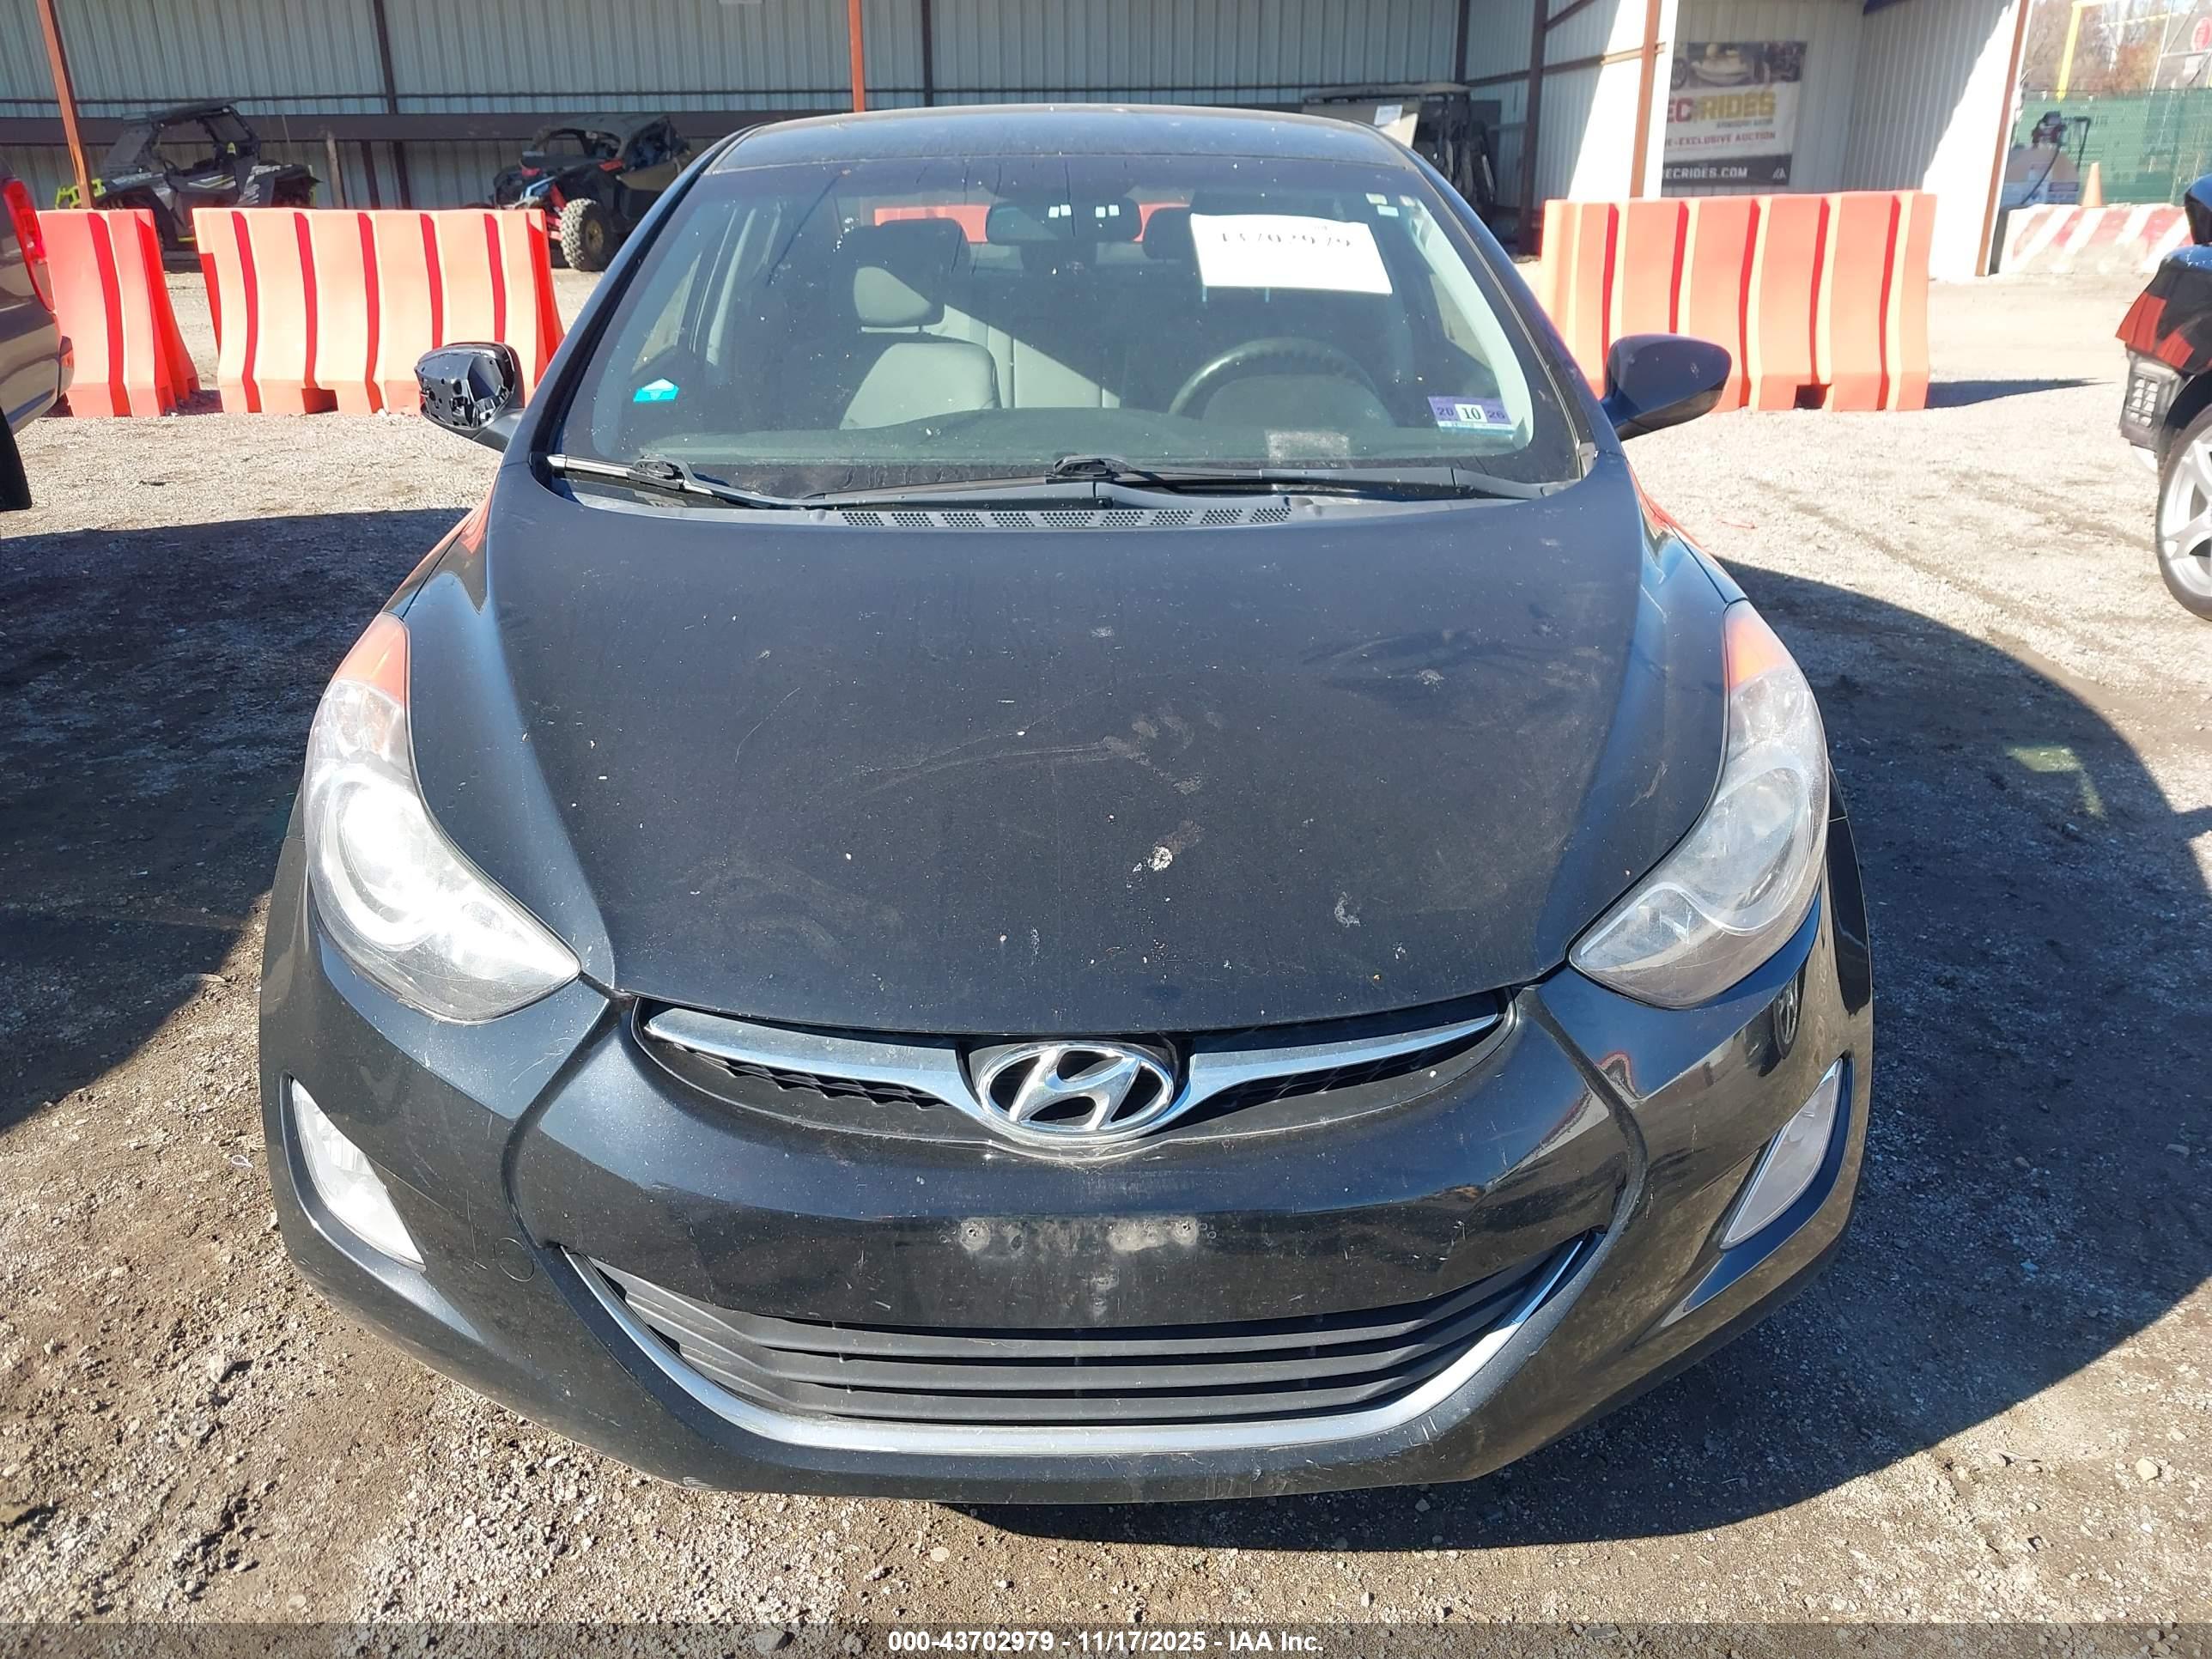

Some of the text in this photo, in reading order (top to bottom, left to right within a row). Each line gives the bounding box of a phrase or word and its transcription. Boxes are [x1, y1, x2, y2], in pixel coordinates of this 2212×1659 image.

[1664, 131, 1776, 147] E-EXCLUSIVE AUCTION
[1662, 167, 1747, 179] ECRIDES.COM
[1436, 406, 1455, 416] 20
[1462, 407, 1481, 420] 10
